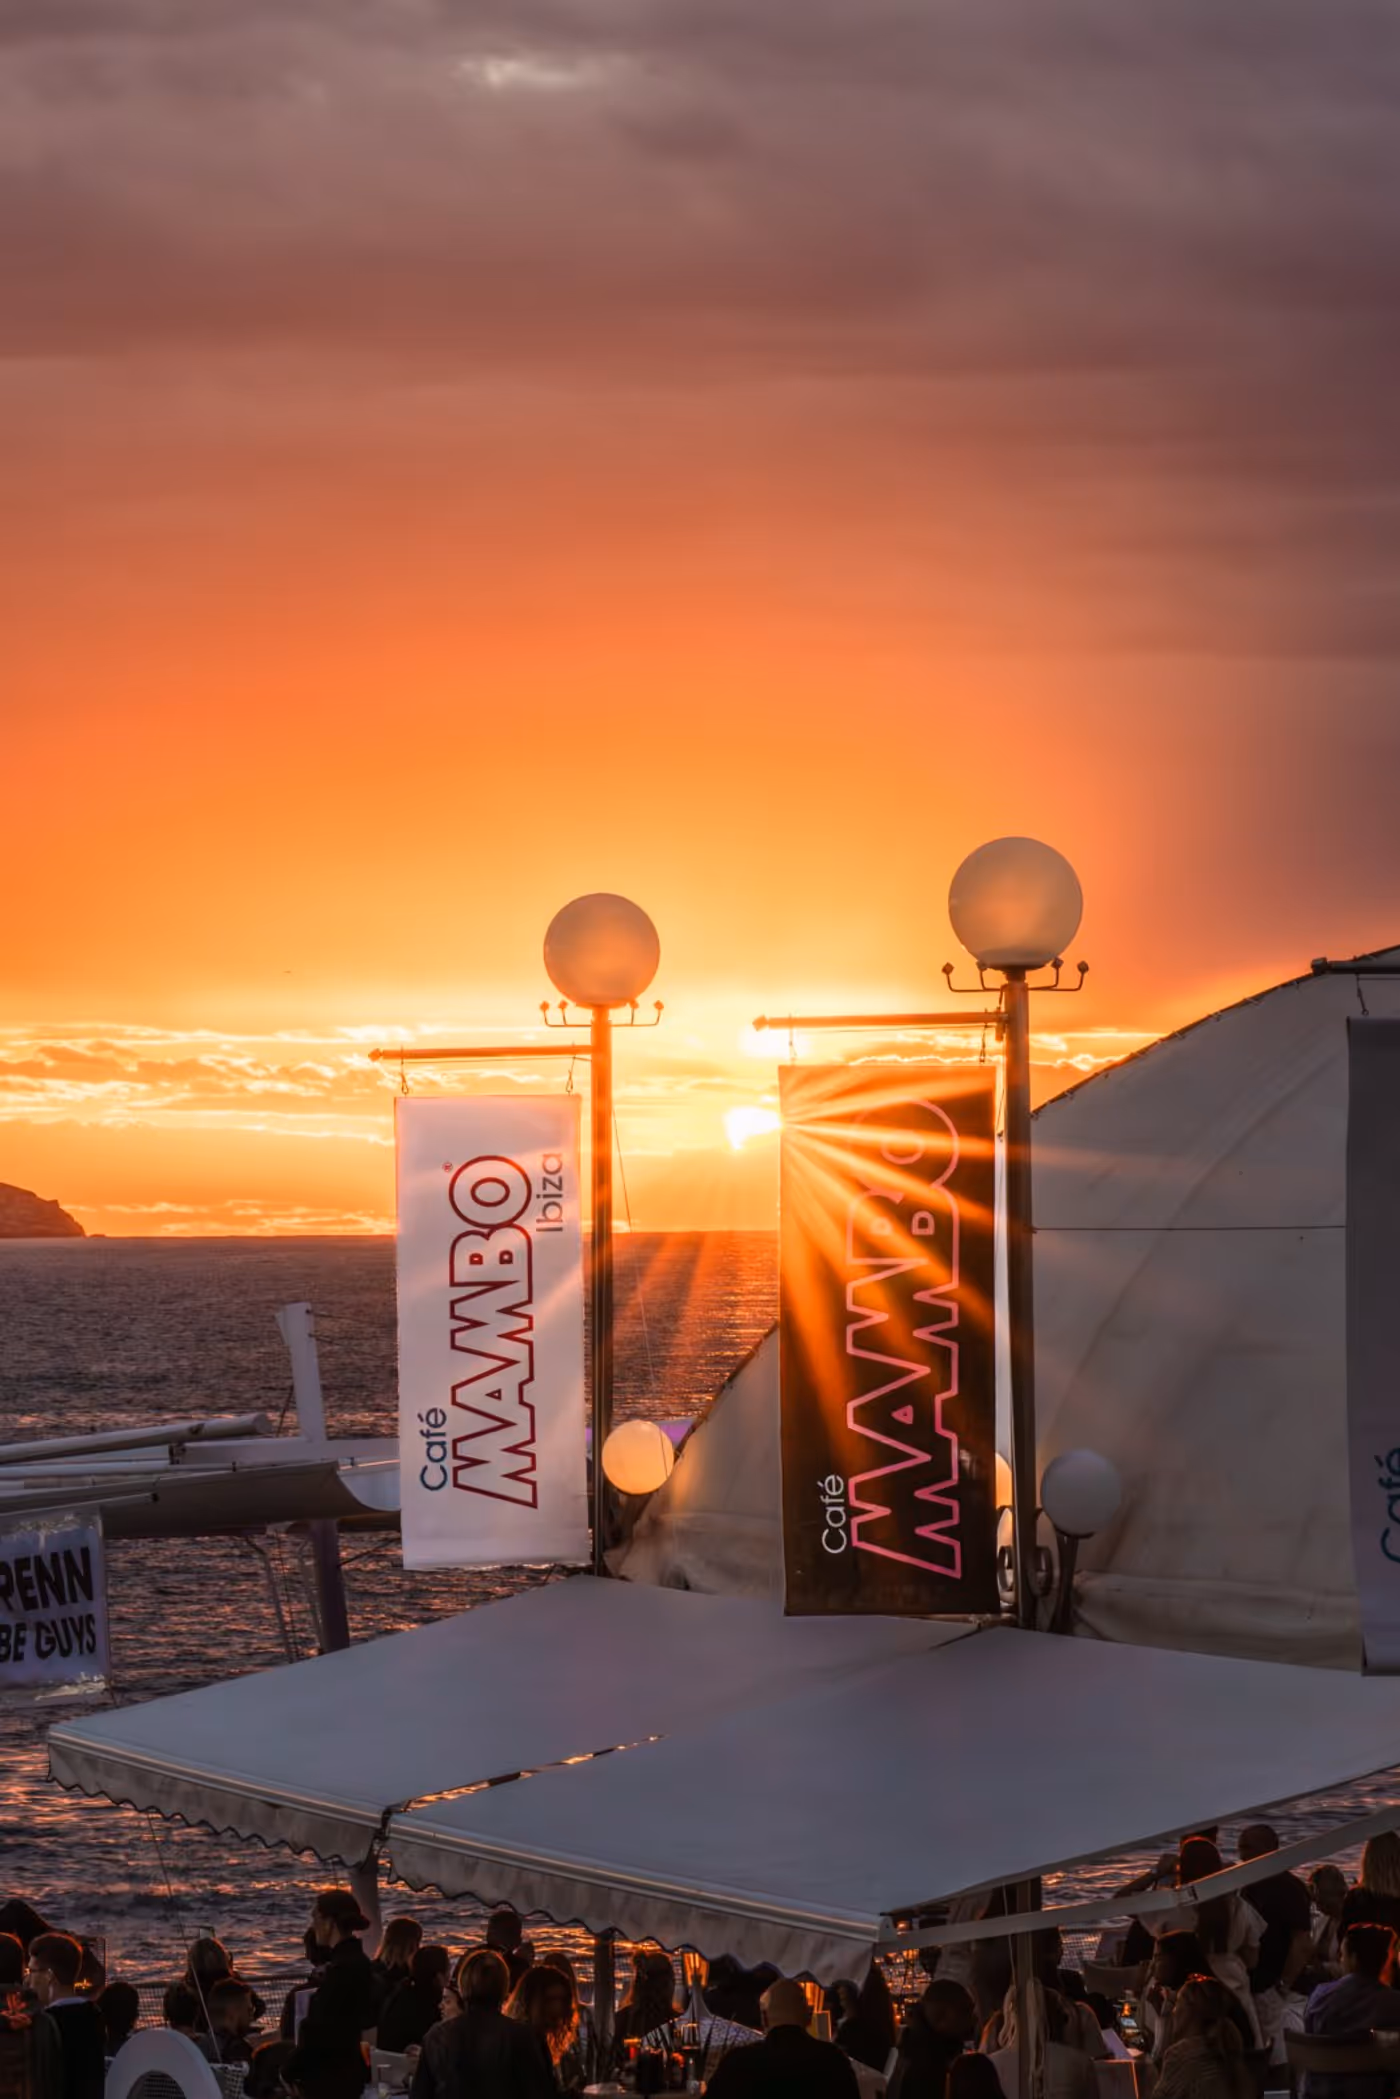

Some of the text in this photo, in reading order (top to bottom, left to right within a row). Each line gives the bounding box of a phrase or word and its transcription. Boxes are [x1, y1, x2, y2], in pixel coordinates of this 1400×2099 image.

[536, 1152, 563, 1232] Ibiza
[417, 1406, 448, 1491] Café
[816, 1473, 847, 1554] Café
[35, 1613, 97, 1660] GUYS
